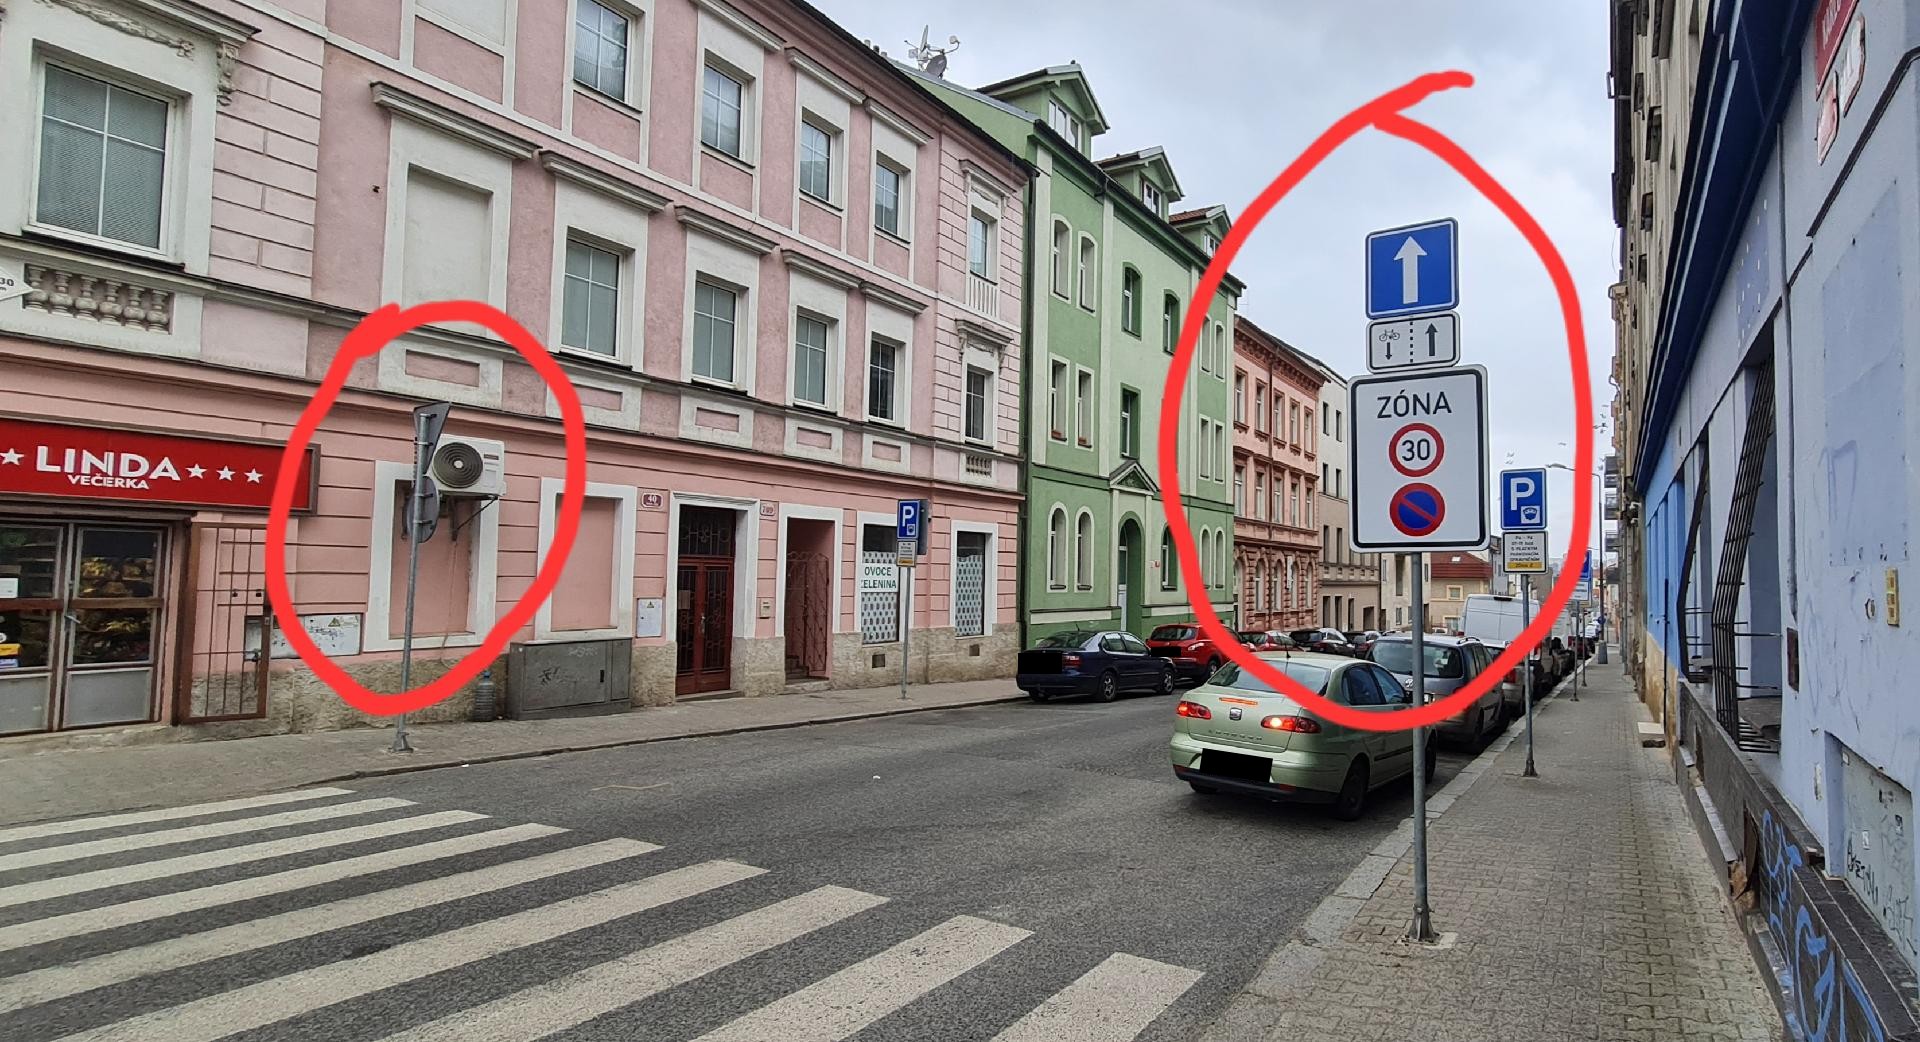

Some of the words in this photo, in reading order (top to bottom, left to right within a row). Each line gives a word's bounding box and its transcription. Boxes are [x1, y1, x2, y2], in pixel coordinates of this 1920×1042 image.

[1377, 389, 1452, 419] ZÓNA
[1401, 438, 1431, 462] 30
[36, 445, 181, 481] LINDA
[67, 473, 150, 490] VEČERKA
[647, 495, 657, 504] 40
[1510, 477, 1535, 511] P
[902, 505, 915, 527] P
[864, 566, 892, 576] OVOCE
